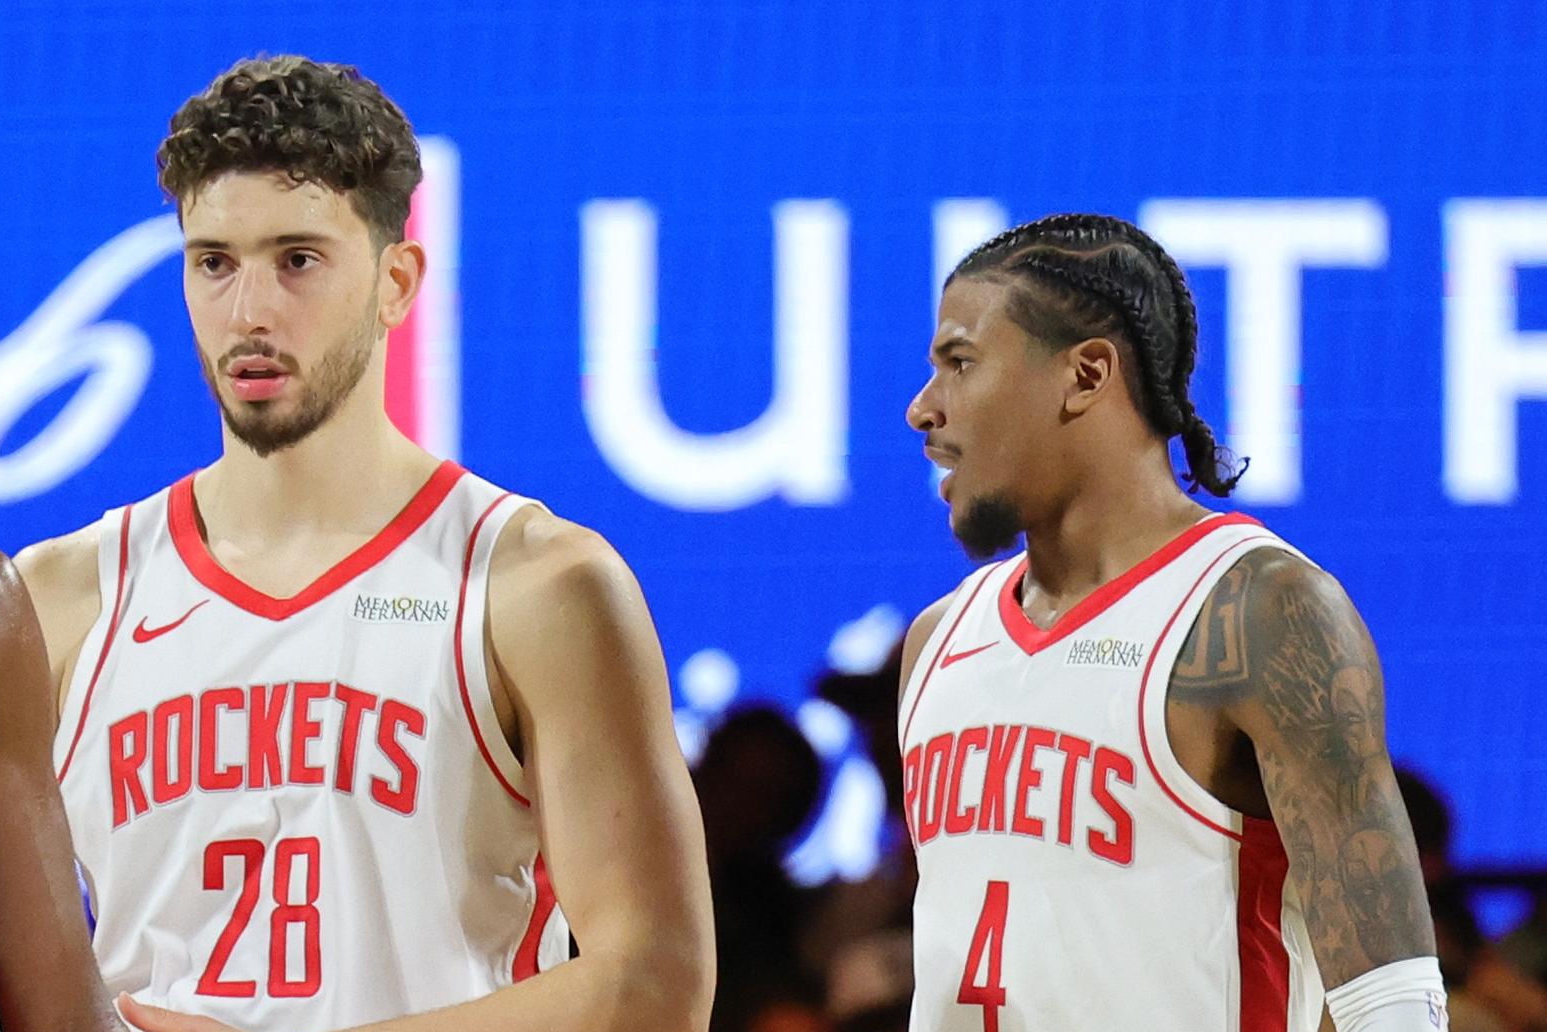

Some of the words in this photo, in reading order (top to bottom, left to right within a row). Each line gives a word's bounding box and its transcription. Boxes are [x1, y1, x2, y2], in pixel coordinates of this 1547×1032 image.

[354, 594, 449, 612] MEMORIAL
[353, 605, 448, 622] HERMANN
[1071, 638, 1143, 657] MEMORIAL
[1066, 648, 1143, 667] HERMANN
[108, 680, 427, 829] ROCKETS
[195, 835, 322, 999] 28
